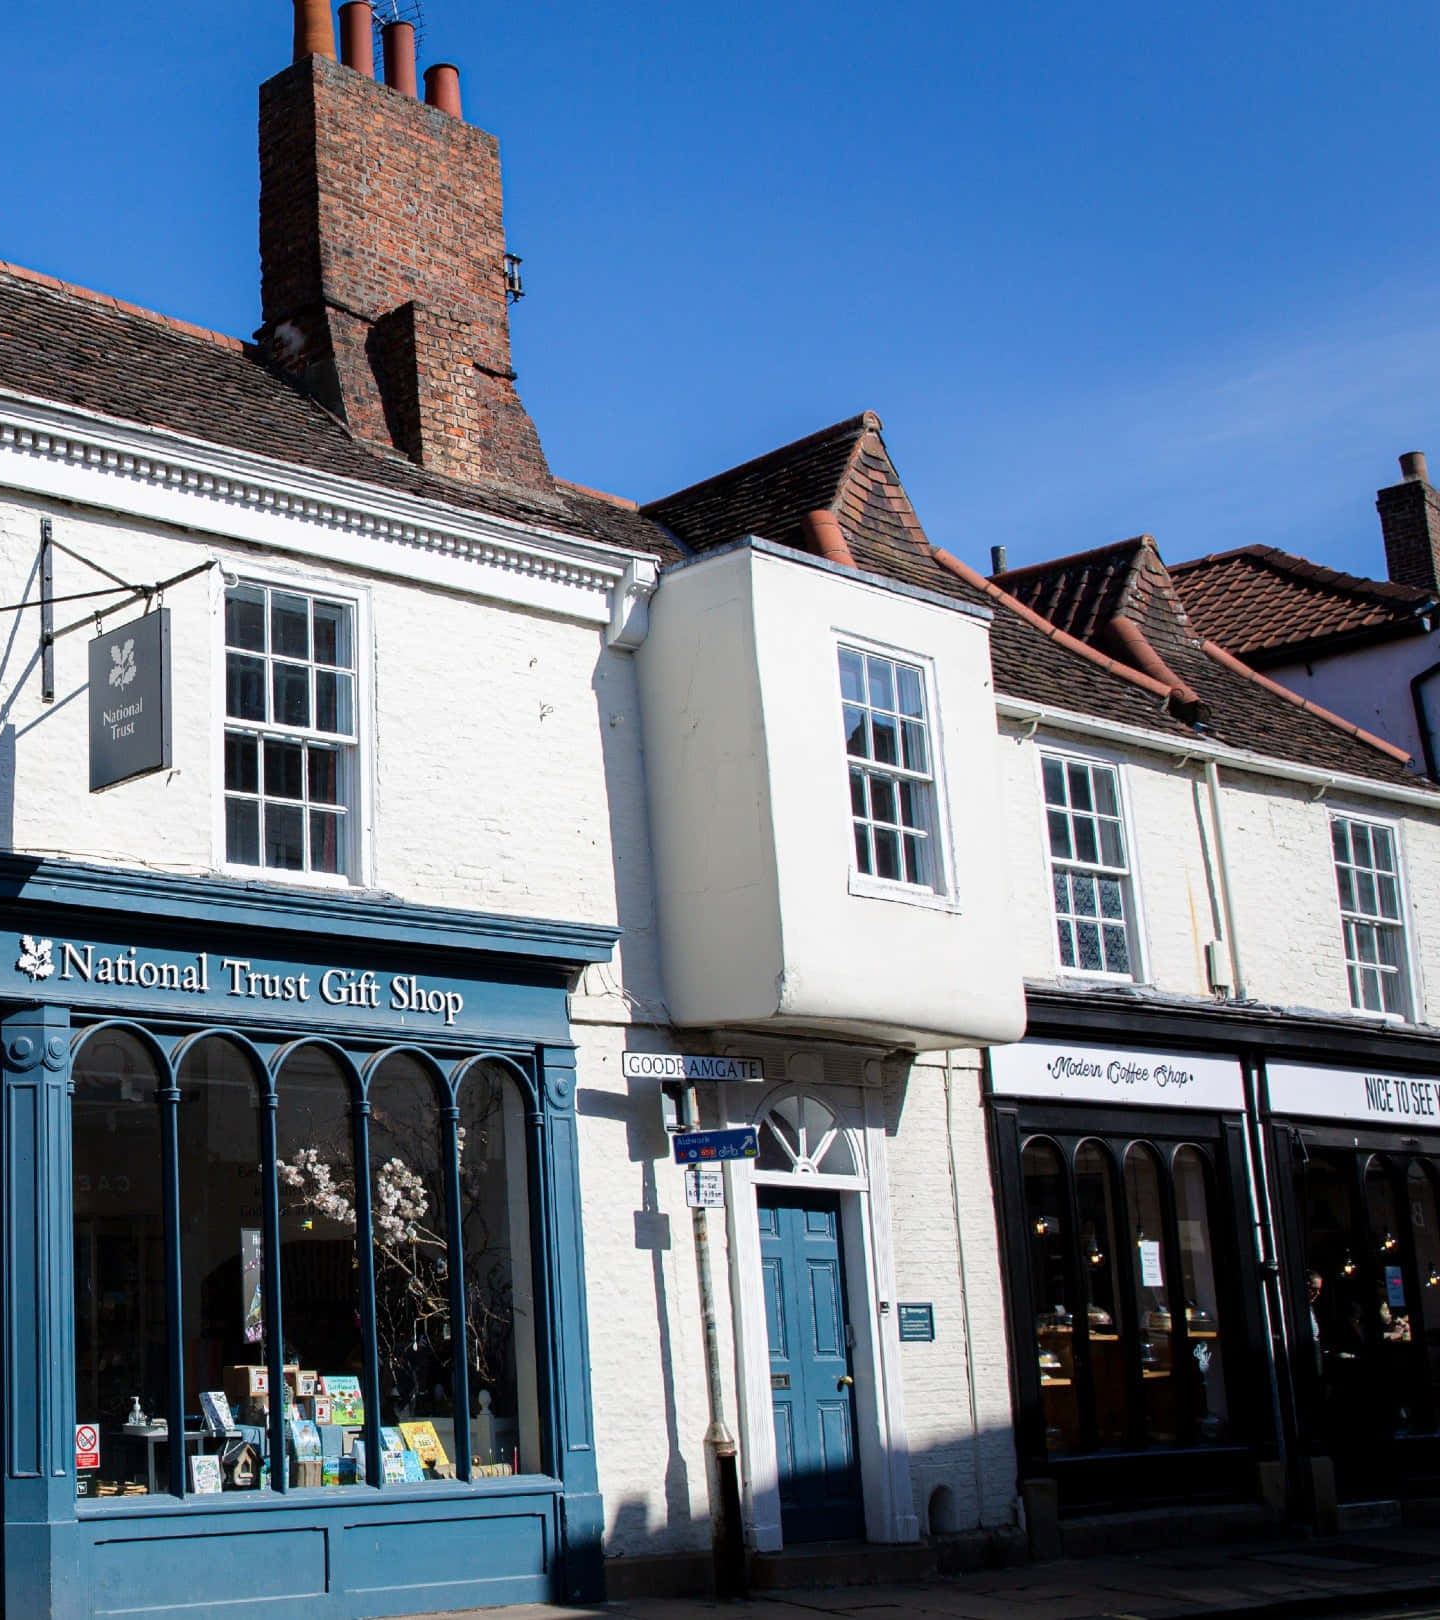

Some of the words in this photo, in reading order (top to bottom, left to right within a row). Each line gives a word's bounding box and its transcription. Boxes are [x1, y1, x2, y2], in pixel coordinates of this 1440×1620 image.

[103, 697, 143, 727] National
[110, 721, 135, 741] Trust
[59, 942, 210, 992] National
[223, 958, 311, 1001] Trust
[320, 968, 382, 1008] Gift
[390, 975, 464, 1026] Shop
[629, 1055, 759, 1079] GOODRAMGATE
[1051, 1055, 1103, 1080] Modern
[1106, 1060, 1150, 1085] Coffee
[1153, 1064, 1189, 1089] Shop
[1365, 1077, 1394, 1113] NICE
[1394, 1080, 1410, 1115] TO
[1410, 1081, 1435, 1117] SEE
